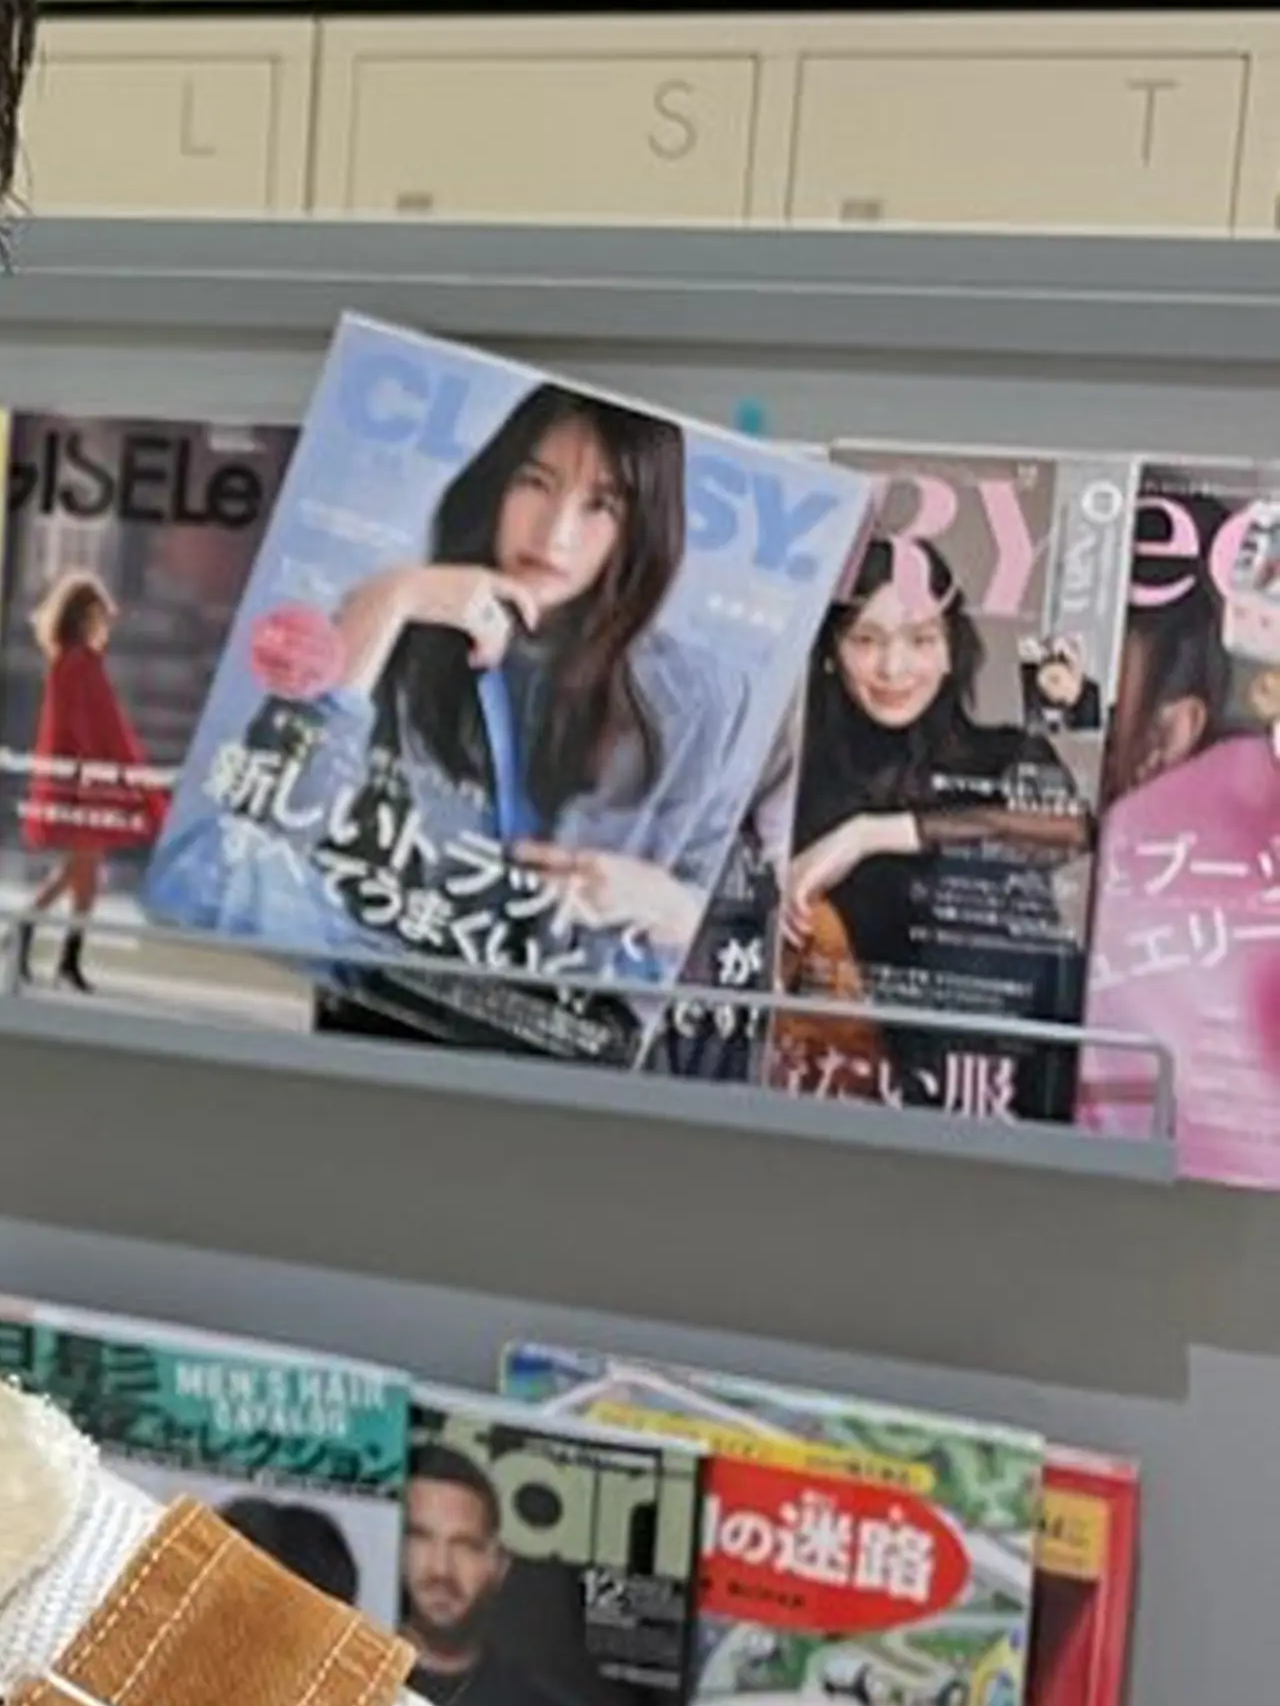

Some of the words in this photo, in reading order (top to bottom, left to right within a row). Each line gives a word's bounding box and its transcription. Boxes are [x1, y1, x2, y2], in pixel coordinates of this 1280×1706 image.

[180, 78, 217, 159] L
[647, 78, 699, 160] S
[1124, 78, 1180, 168] T
